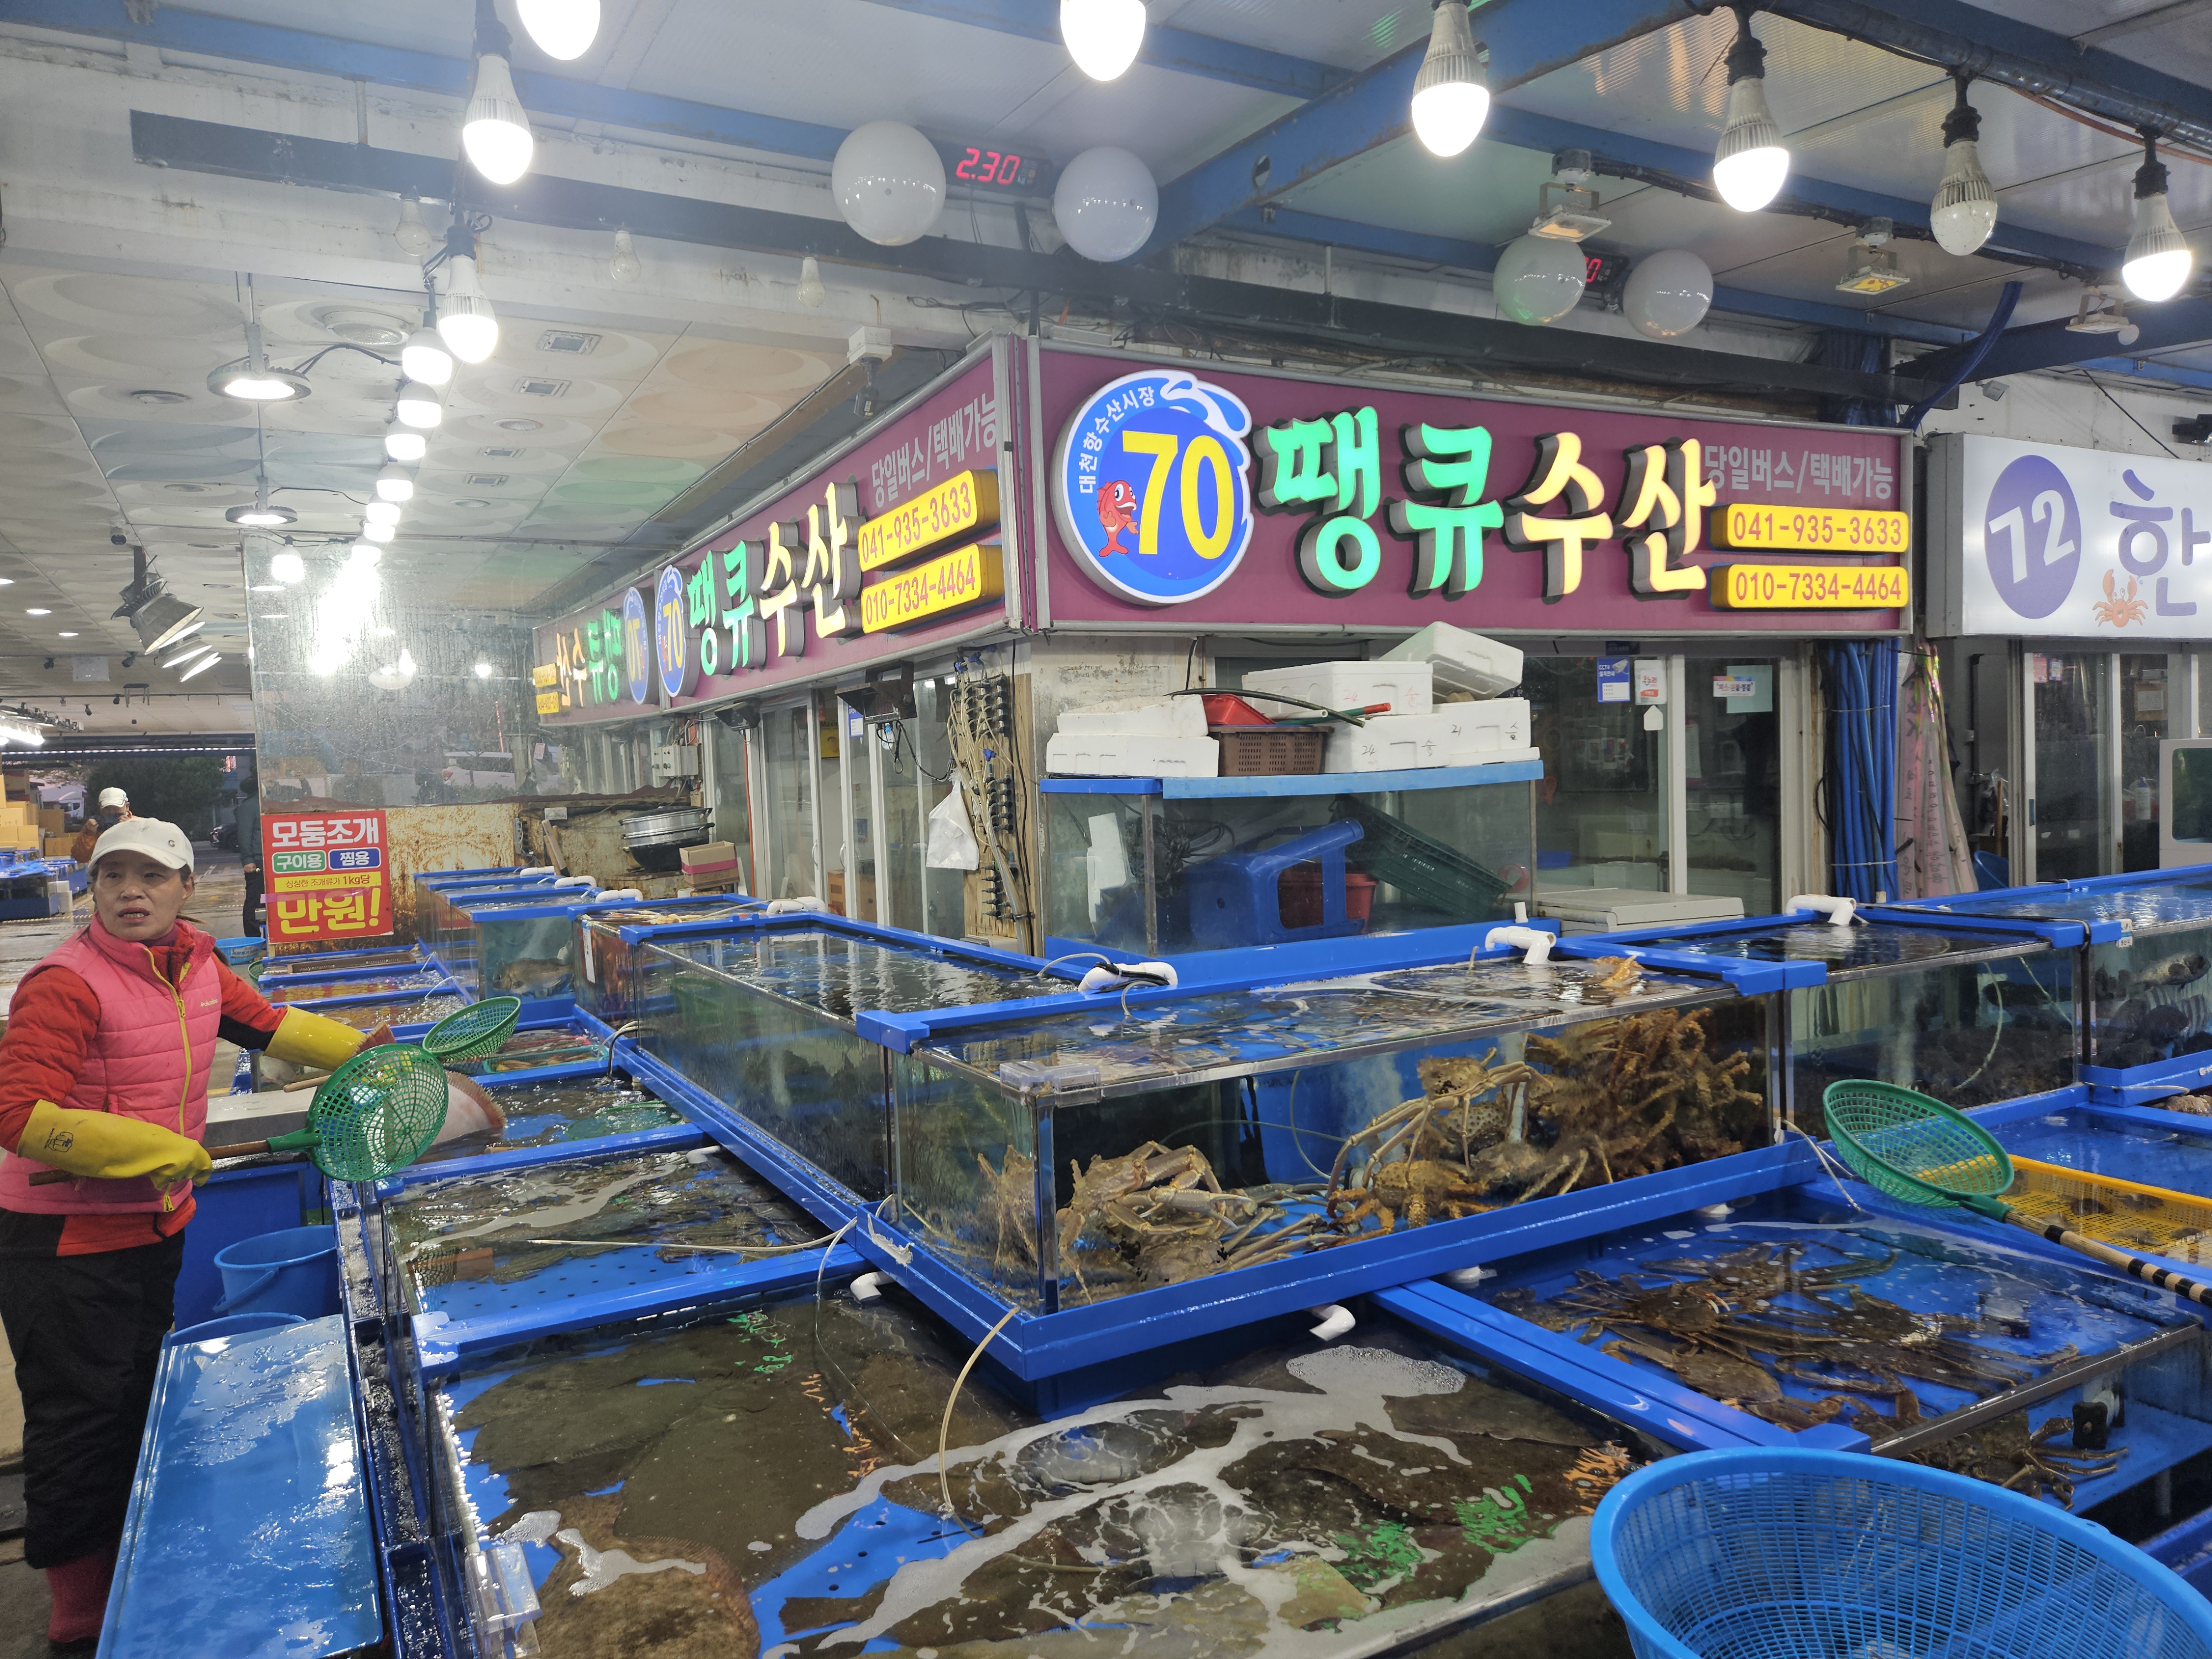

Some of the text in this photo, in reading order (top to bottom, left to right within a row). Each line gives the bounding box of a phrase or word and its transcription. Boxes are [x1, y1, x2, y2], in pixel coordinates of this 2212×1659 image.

[956, 148, 1020, 185] 2.30
[872, 393, 997, 508] 당일버스/택배가능
[1079, 385, 1155, 494] 대천항수산시장
[1122, 430, 1234, 560] 70
[1705, 445, 1893, 499] 당일버스/택배가능
[862, 481, 972, 563] 041-935-3633
[1733, 511, 1902, 545] 041-935-3633
[1988, 489, 2075, 585] 72
[686, 482, 848, 676] 땡큐수산
[865, 555, 976, 625] 010-7334-4464
[1735, 571, 1901, 601] 010-7334-4464
[663, 597, 682, 672] 70
[272, 817, 379, 847] 모둠조개
[340, 851, 370, 867] 찜용
[276, 853, 322, 870] 구이용
[285, 874, 371, 888] 싱싱한 조개류가 1kg당
[277, 887, 381, 934] 만원!
